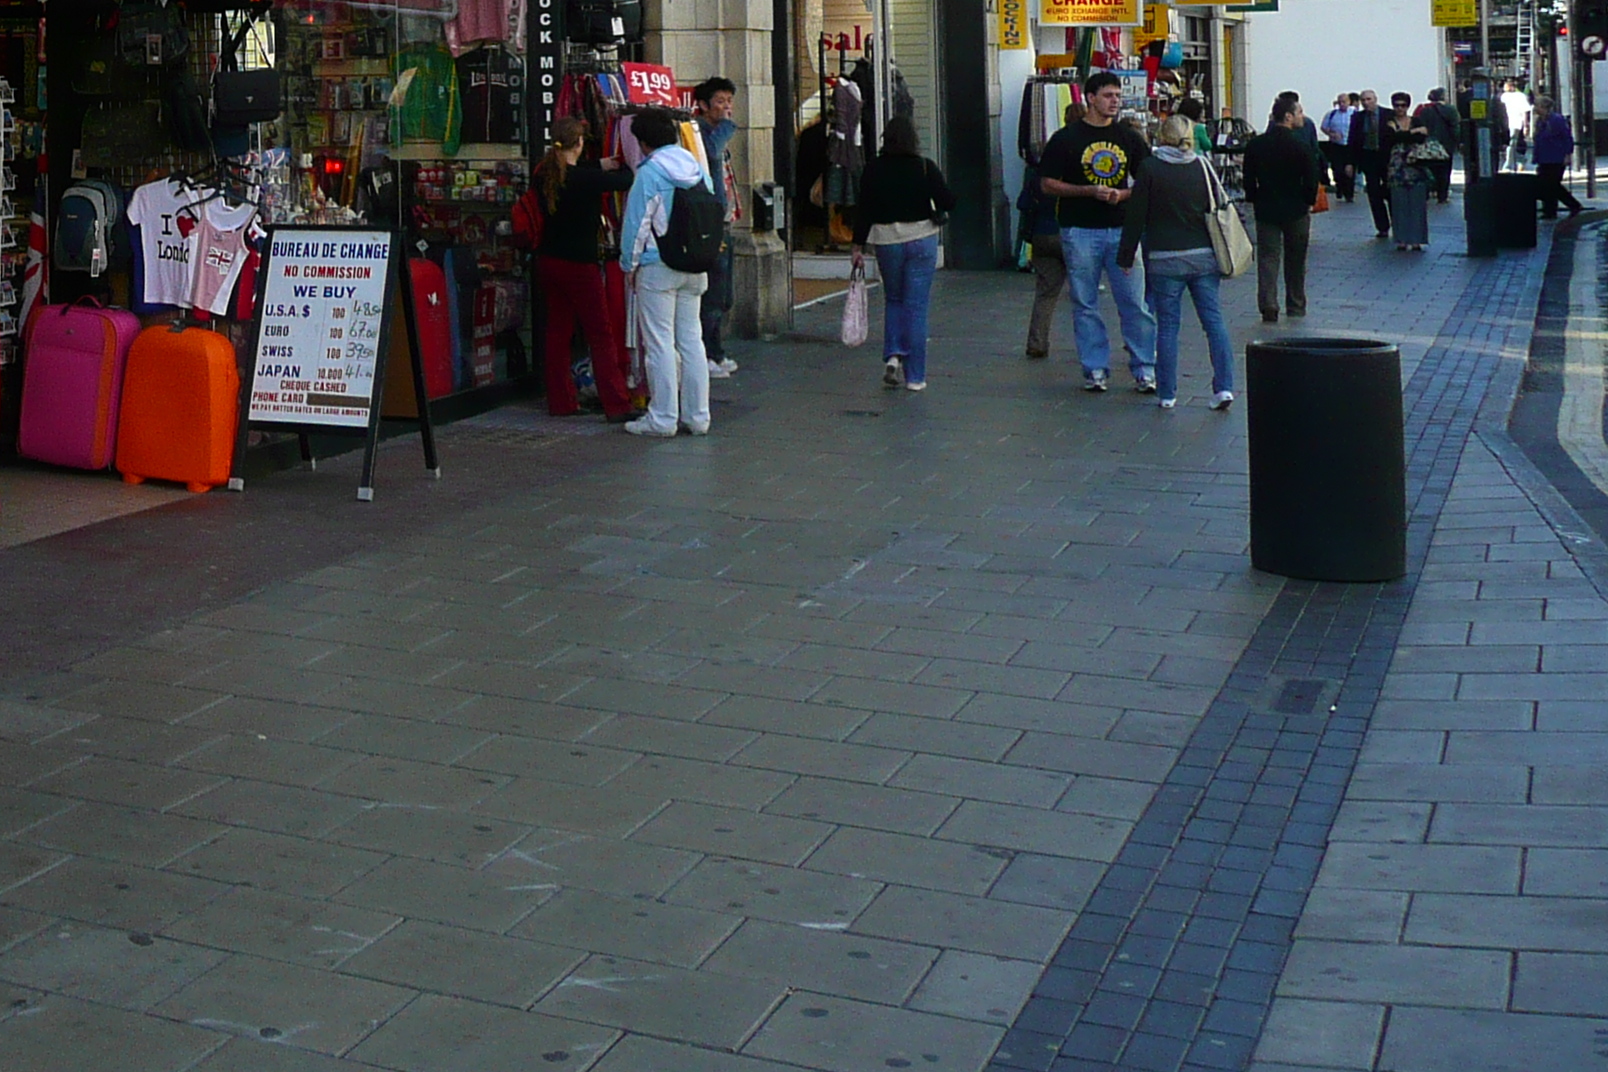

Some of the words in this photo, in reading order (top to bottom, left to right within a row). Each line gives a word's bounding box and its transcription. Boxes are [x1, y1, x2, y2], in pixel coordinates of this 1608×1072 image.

[630, 70, 671, 94] £1.99
[161, 214, 172, 235] I
[273, 242, 319, 257] BUREAU
[322, 243, 337, 257] DE
[340, 243, 388, 259] CHANGE
[284, 265, 298, 277] NO
[304, 266, 371, 278] COMMISSION
[294, 286, 317, 297] WE
[324, 286, 356, 298] BUY
[265, 326, 289, 336] EURO
[262, 346, 293, 357] SWISS
[258, 365, 300, 377] JAPAN
[280, 380, 311, 391] CHEQUE
[314, 382, 346, 392] CASHED
[253, 392, 278, 402] PHONE
[282, 394, 304, 403] CARD
